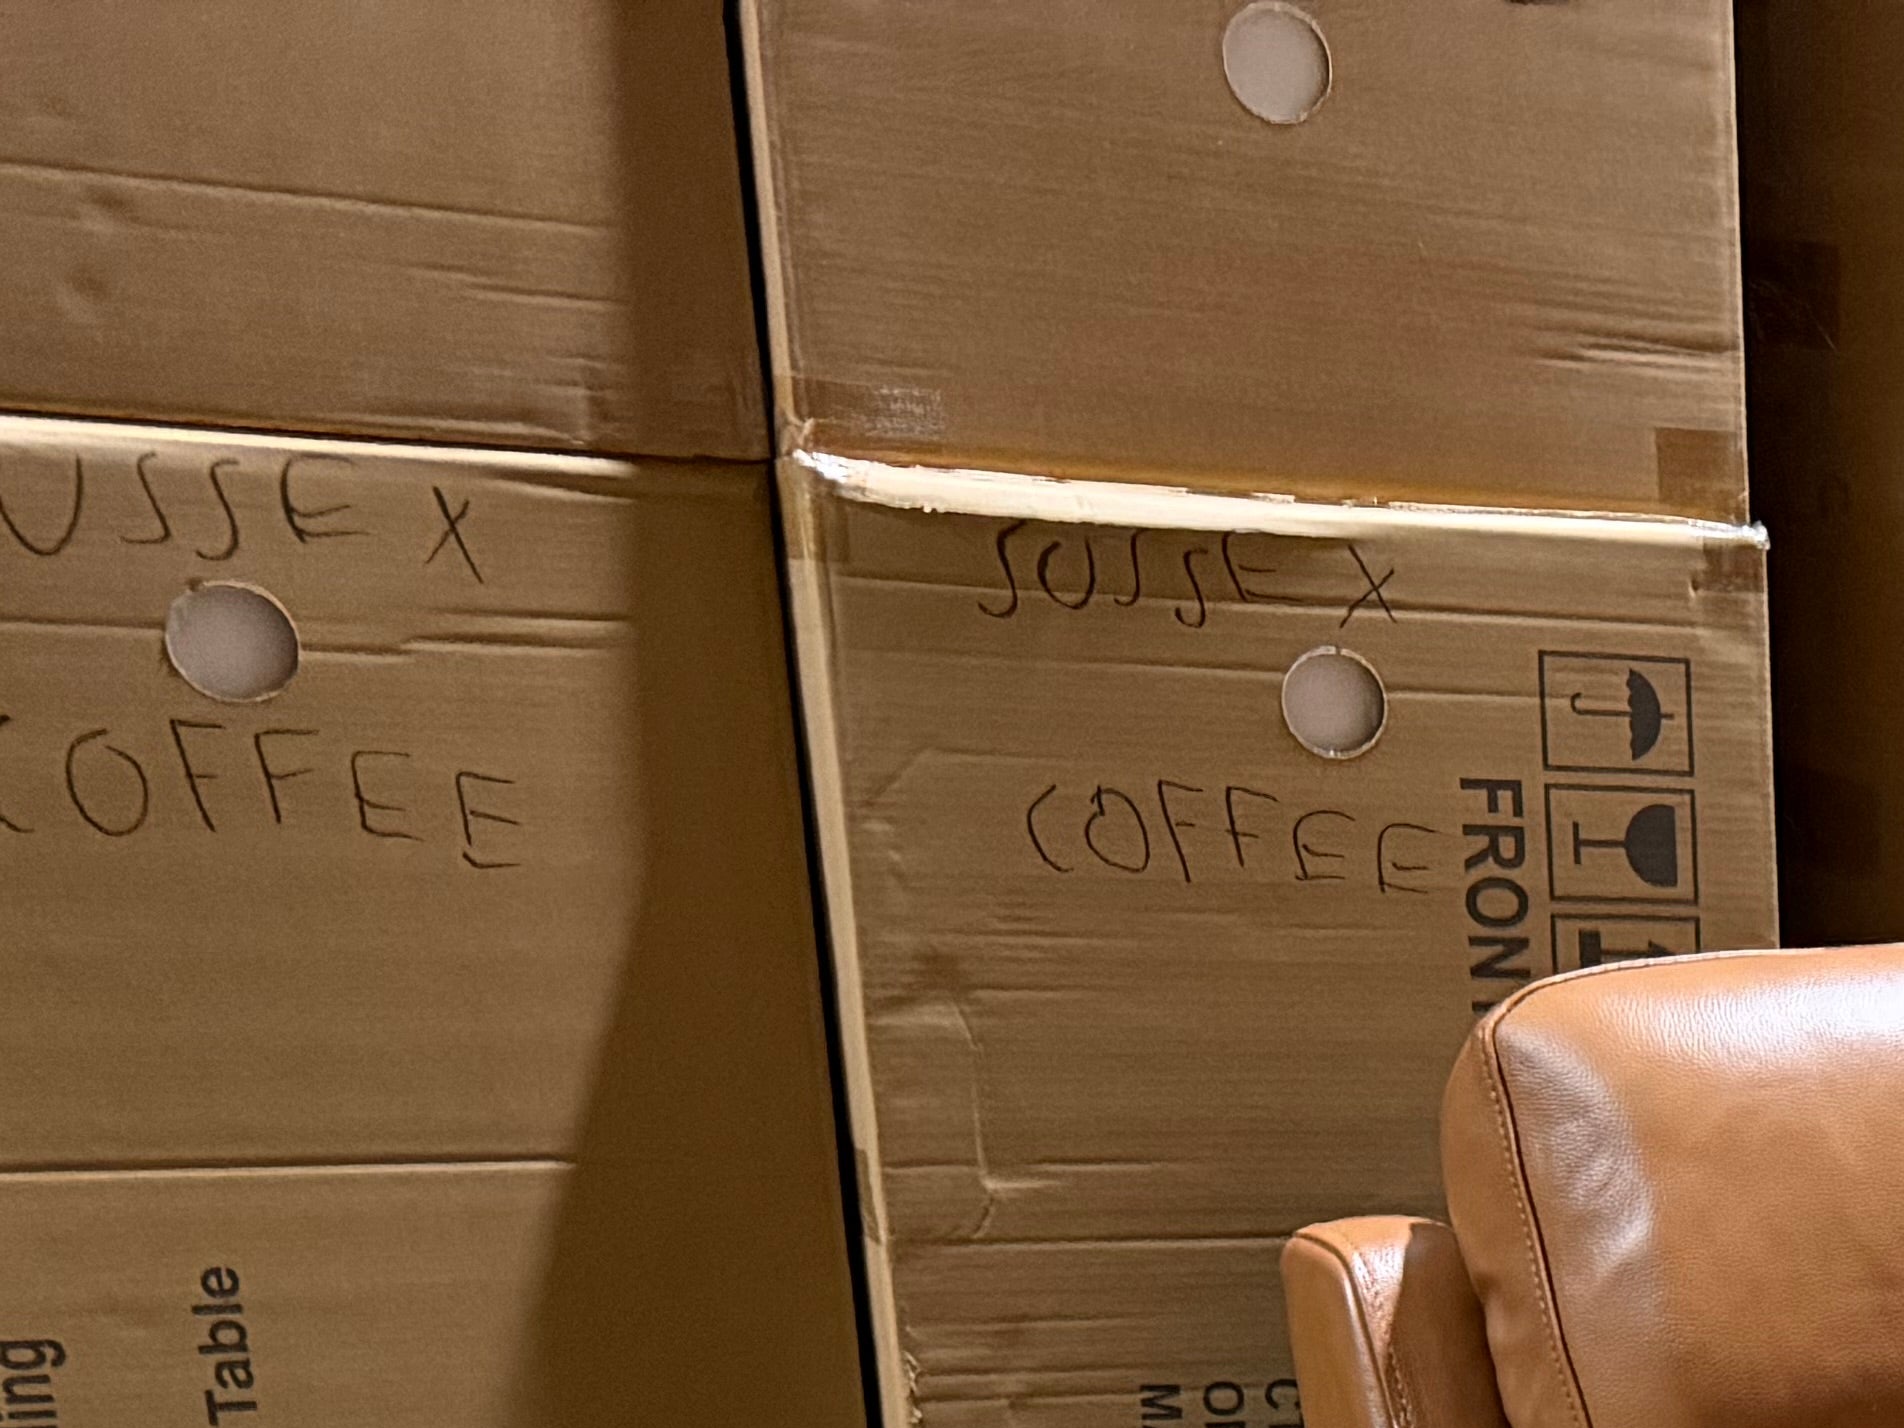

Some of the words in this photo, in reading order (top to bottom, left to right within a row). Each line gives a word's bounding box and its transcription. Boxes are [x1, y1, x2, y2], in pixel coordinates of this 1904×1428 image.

[0, 715, 522, 869] OFFEE
[1027, 779, 1438, 894] COFFEE
[192, 1264, 258, 1427] Table
